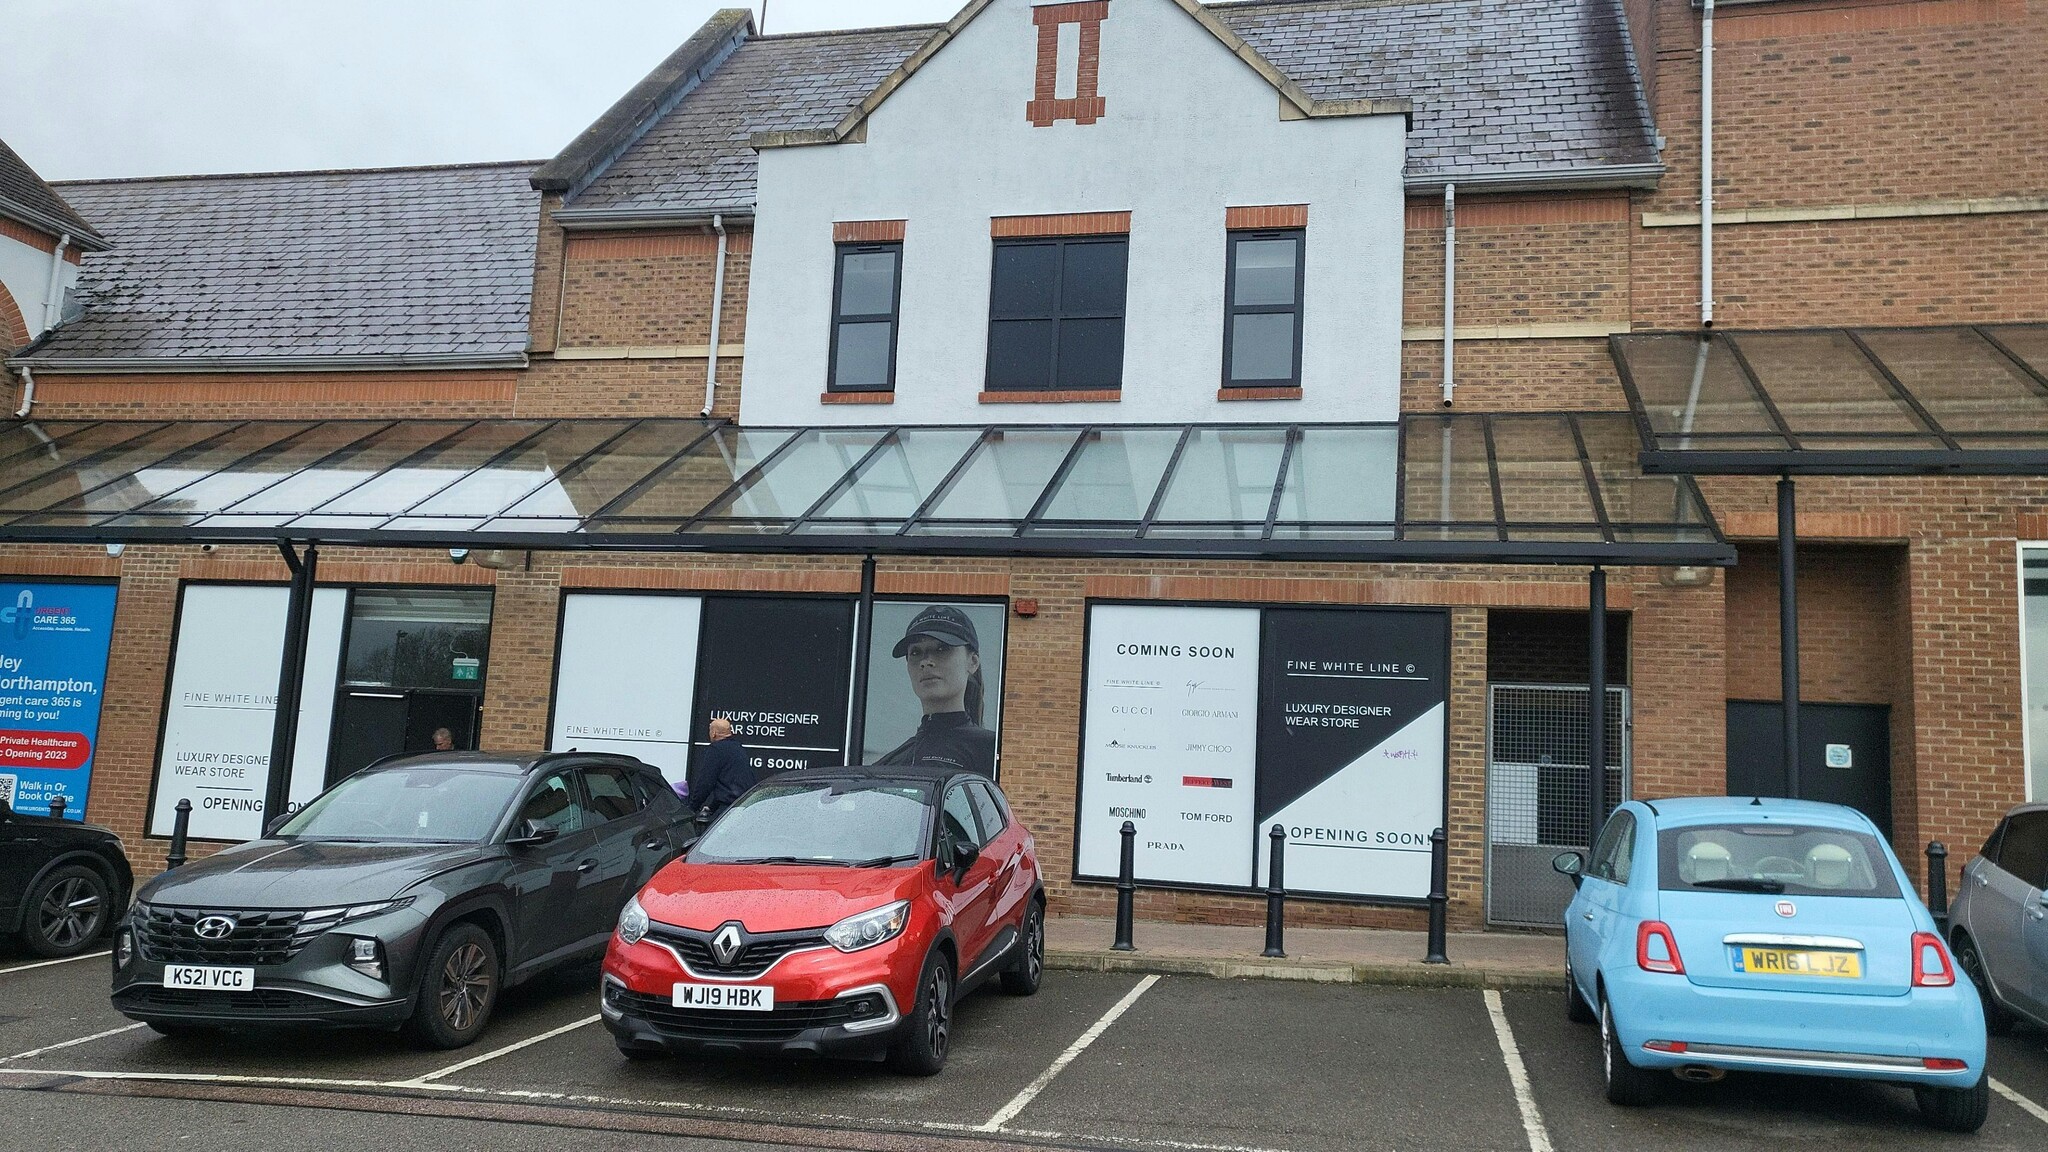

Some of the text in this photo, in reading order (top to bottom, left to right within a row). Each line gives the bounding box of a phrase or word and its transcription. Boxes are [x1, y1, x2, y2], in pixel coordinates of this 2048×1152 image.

[35, 607, 70, 615] URGENT
[33, 616, 77, 625] CARE 365
[1117, 644, 1235, 658] COMING SOON
[1287, 661, 1317, 670] FINE
[1322, 662, 1364, 672] WHITE
[1370, 663, 1400, 673] LINE
[0, 675, 97, 695] orthampton,
[25, 698, 49, 706] care
[51, 697, 71, 707] 365
[72, 697, 82, 707] is
[184, 692, 210, 702] FINE
[214, 693, 250, 704] WHITE
[24, 709, 35, 719] to
[37, 710, 60, 721] you!
[1111, 705, 1153, 715] GUCCI
[1181, 708, 1238, 719] GIORGIO ARMANI
[1285, 703, 1392, 716] LUXURY DESIGNER
[710, 710, 819, 725] LUXURY DESIGNER
[1285, 716, 1360, 728] WEAR STORE
[566, 726, 589, 734] FINE
[593, 727, 624, 736] WHITE
[628, 728, 651, 737] LINE
[746, 725, 785, 737] STORE
[0, 736, 77, 748] Private Healthcare
[5, 748, 43, 761] Opening
[44, 751, 68, 760] 2023
[1185, 744, 1232, 753] JIMMY CHOO
[176, 751, 269, 766] LUXURY DESIGNE
[767, 759, 808, 770] SOON!
[175, 765, 246, 779] WEAR STORE
[1106, 773, 1143, 784] Timberland
[20, 780, 67, 792] Walk in Or
[18, 791, 42, 801] Book
[203, 796, 263, 812] OPENING
[1109, 806, 1147, 819] MOSCHINO
[1180, 812, 1233, 823] TOM FORD
[1290, 827, 1432, 846] OPENING SOON!
[1147, 841, 1185, 851] PRADA
[1751, 951, 1850, 974] WR16 LJZ
[173, 968, 243, 987] KS21 VCG
[683, 986, 762, 1007] WJ19 HBK
